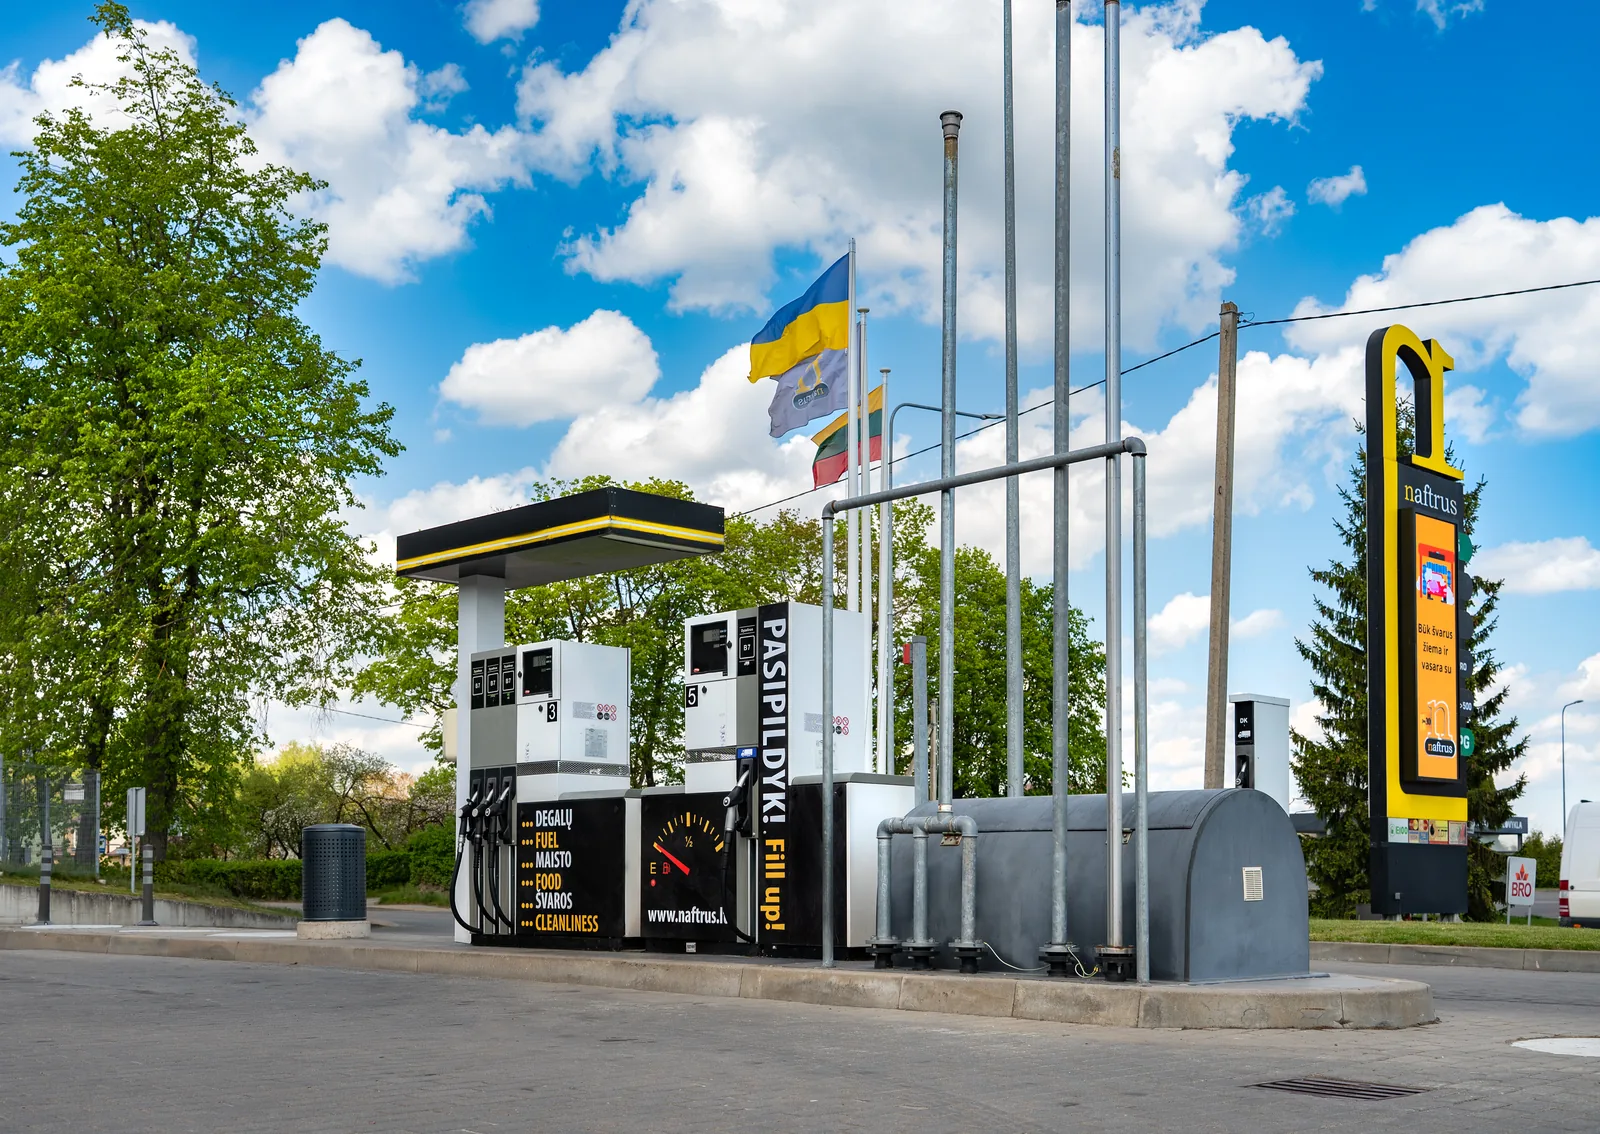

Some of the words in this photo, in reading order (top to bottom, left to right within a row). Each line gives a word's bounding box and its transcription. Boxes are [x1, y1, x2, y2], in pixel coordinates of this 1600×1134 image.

[1404, 484, 1458, 515] naftrus
[1418, 623, 1431, 635] Būk
[1432, 626, 1453, 639] švarus
[1443, 645, 1449, 656] ir
[1421, 661, 1443, 673] vasara
[1444, 665, 1452, 674] su
[687, 688, 696, 705] 5
[548, 703, 556, 720] 3
[762, 618, 786, 823] PASIPILDYK!
[1427, 741, 1453, 754] naftrus
[535, 808, 573, 831] DEGALŲ
[535, 831, 559, 849] FUEL
[535, 850, 572, 869] MAISTO
[765, 839, 785, 879] Fill
[649, 862, 657, 875] E
[535, 873, 562, 891] FOOD
[1511, 882, 1532, 897] BRO
[535, 889, 573, 909] ŠVAROS
[760, 887, 785, 930] up!
[535, 913, 599, 932] CLEANLINESS
